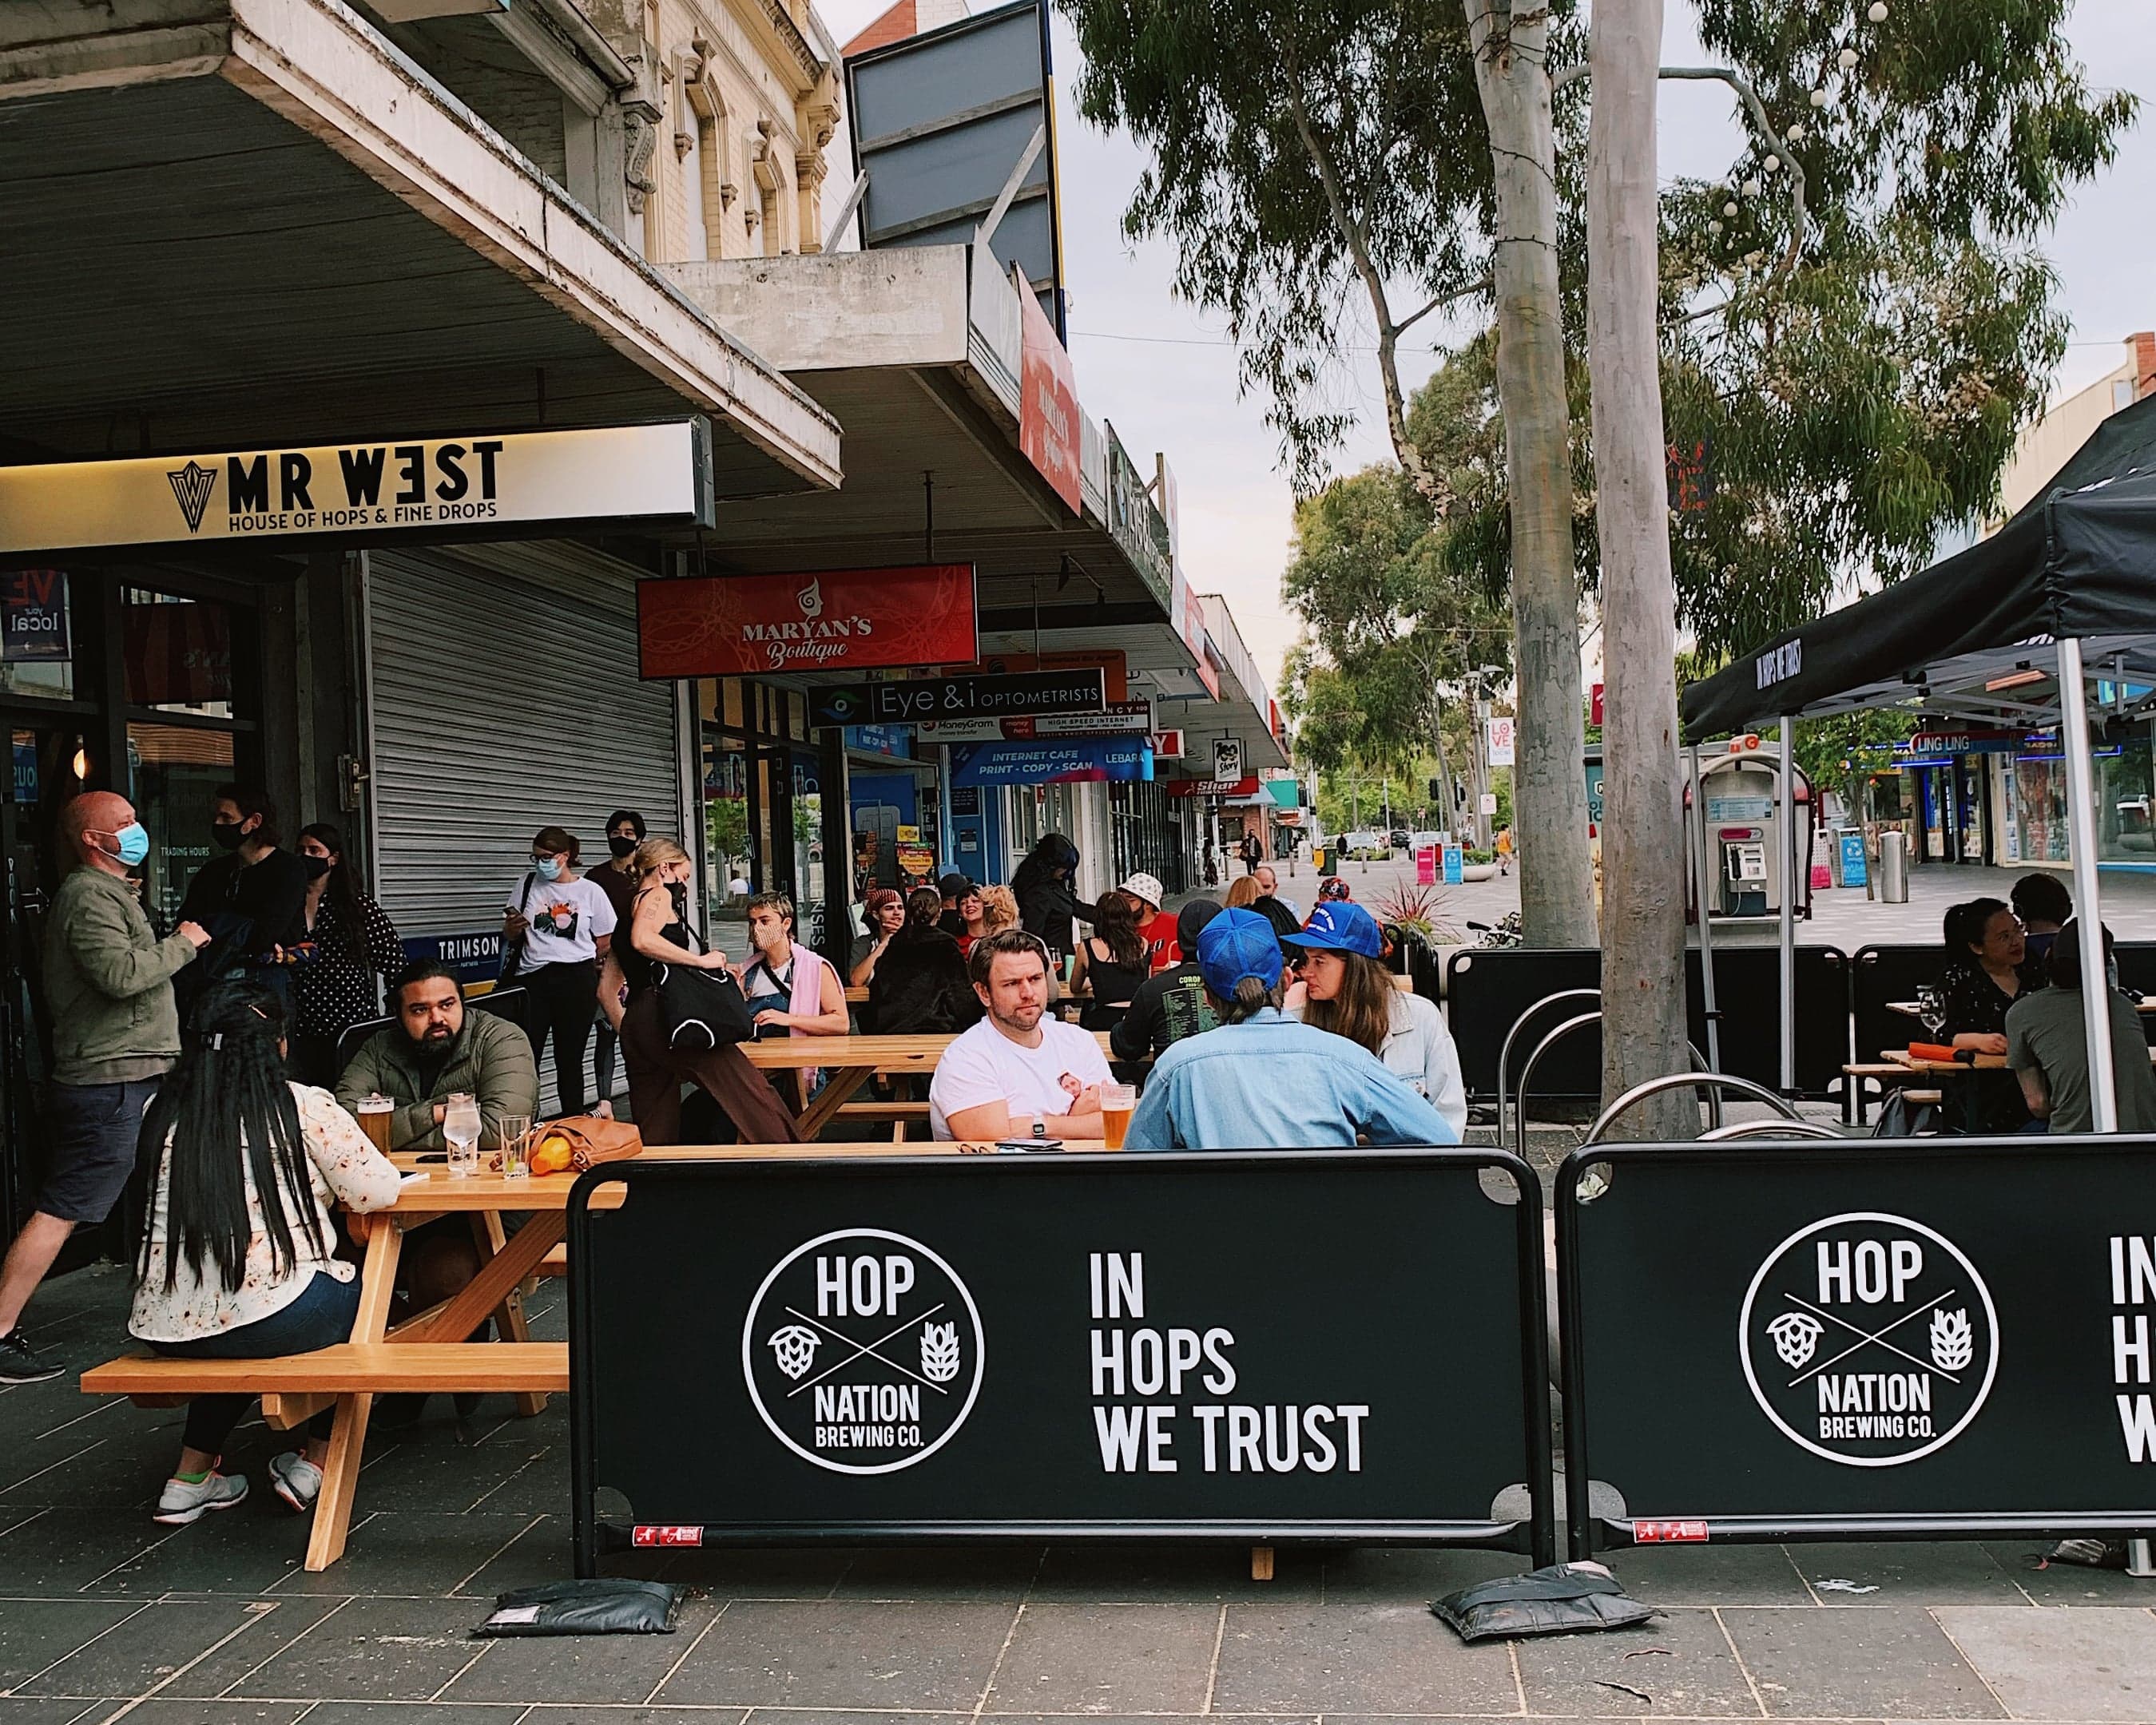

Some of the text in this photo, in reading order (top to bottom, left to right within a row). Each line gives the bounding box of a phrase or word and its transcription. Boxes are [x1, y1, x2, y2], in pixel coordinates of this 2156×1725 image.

[228, 453, 315, 514] MR
[229, 502, 497, 533] HOUSE OF HOPS & FINE DROPS
[743, 616, 872, 641] MARYAN'S
[767, 639, 848, 670] Boutique
[881, 687, 935, 717] Eye
[943, 684, 965, 709] &
[980, 688, 1098, 707] OPTOMETRISTS
[938, 720, 994, 729] MoneyGram
[1491, 723, 1510, 736] LO
[1491, 735, 1511, 748] VE
[1918, 736, 1943, 753] LING
[1945, 735, 1969, 751] LING
[979, 764, 1013, 775] PRINT
[1022, 763, 1054, 773] COPY
[1062, 762, 1093, 771] SCAN
[992, 750, 1079, 762] INTERNET CAFE
[1106, 753, 1145, 763] LEBARA
[1219, 761, 1238, 773] Story
[161, 847, 210, 857] TRADING HOURS
[439, 936, 500, 960] TRIMSON
[1817, 1240, 1923, 1303] HOP
[816, 1255, 915, 1317] HOP
[1088, 1251, 1144, 1319] IN
[1090, 1326, 1237, 1396] HOPS
[815, 1384, 919, 1423] NATION
[1817, 1374, 1932, 1413] NATION
[816, 1424, 926, 1449] BREWING CO.
[1093, 1404, 1370, 1473] WE TRUST
[1819, 1415, 1937, 1439] BREWING CO.
